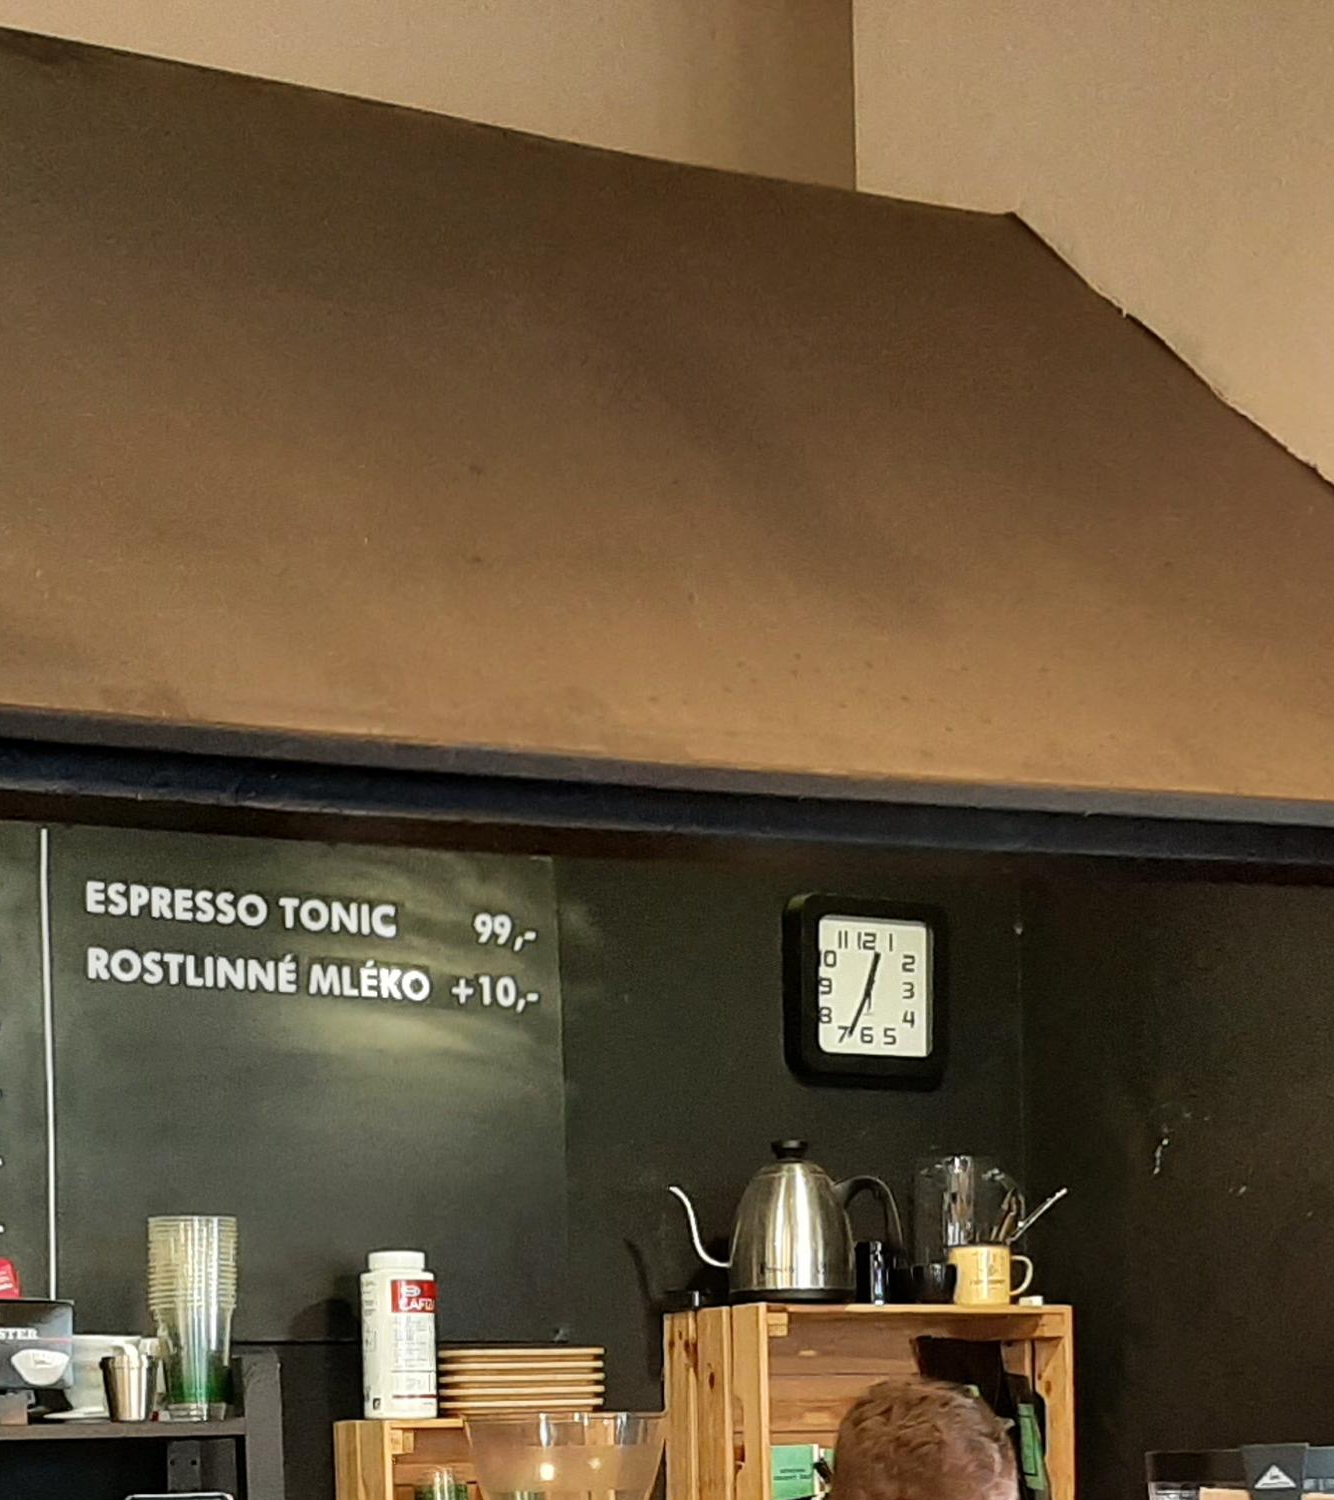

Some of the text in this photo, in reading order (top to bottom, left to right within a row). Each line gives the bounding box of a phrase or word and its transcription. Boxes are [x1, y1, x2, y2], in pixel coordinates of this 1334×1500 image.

[86, 880, 397, 938] ESPRESSO TONIC
[473, 913, 536, 951] 99,-
[838, 930, 848, 949] 11
[857, 931, 877, 950] 12
[818, 949, 836, 968] 0
[902, 954, 915, 972] 2
[87, 947, 539, 1013] ROSTLINNÉ MLÉKO +10,-
[902, 982, 915, 999] 3
[819, 1007, 832, 1024] 8
[902, 1011, 915, 1028] 4
[860, 1027, 874, 1043] 6
[883, 1027, 897, 1045] 5
